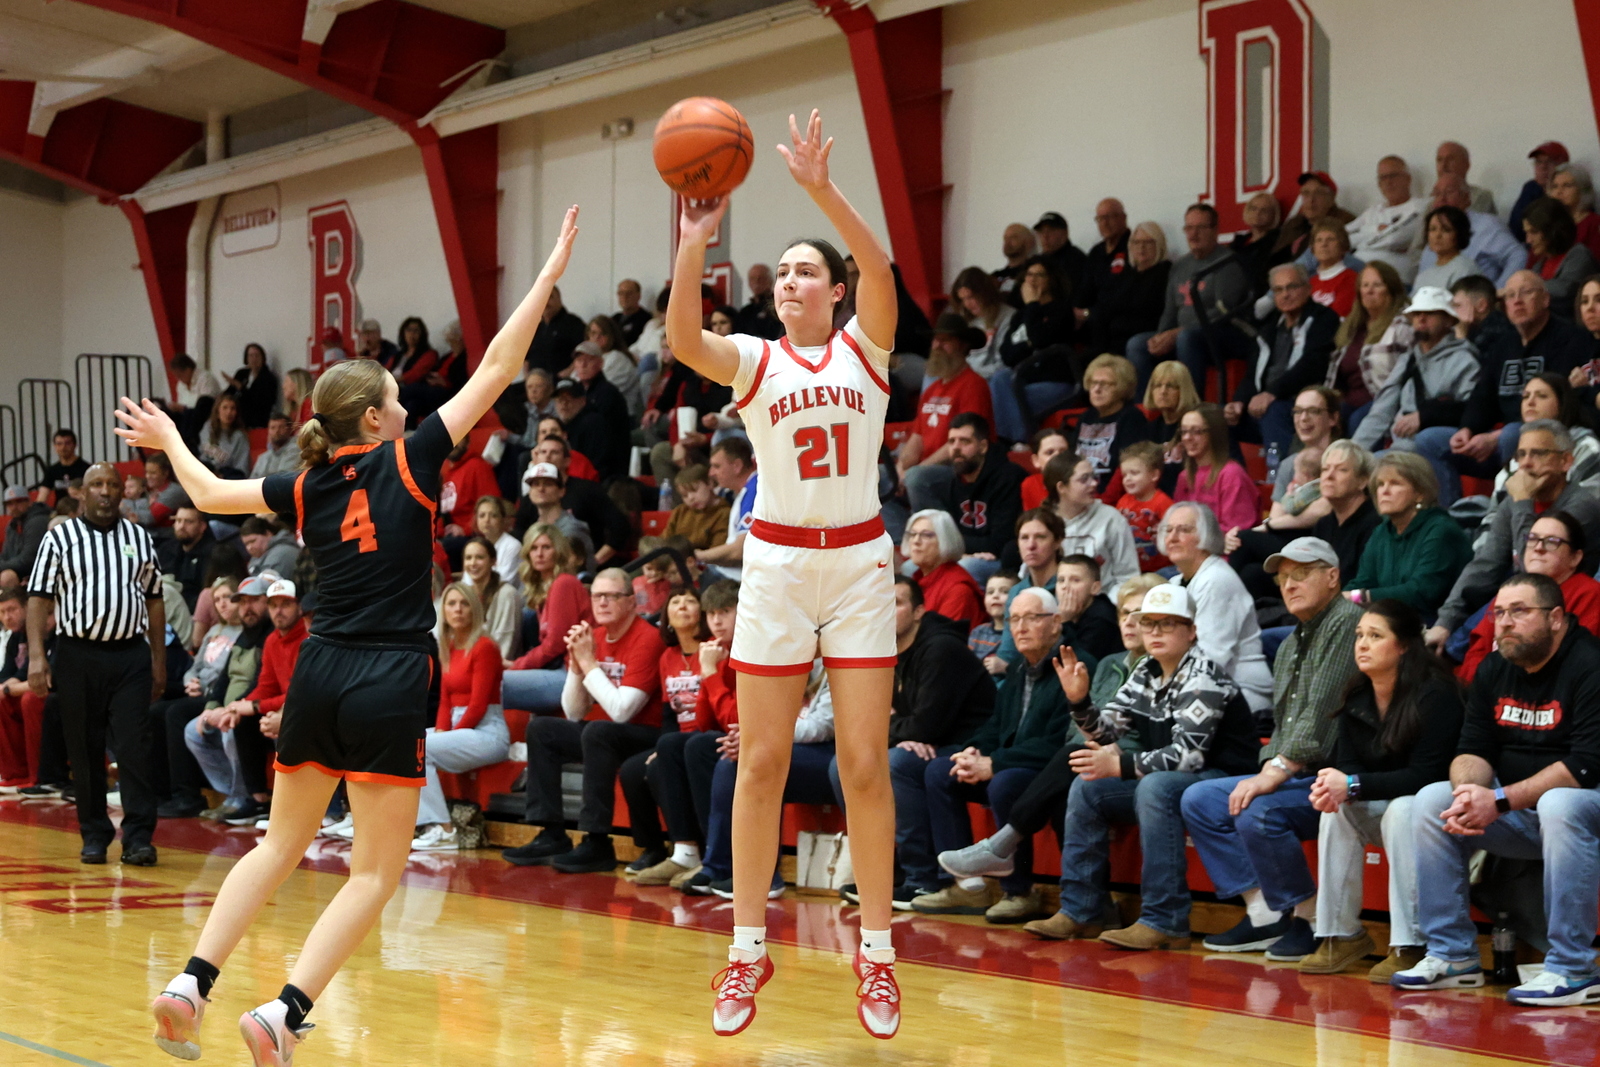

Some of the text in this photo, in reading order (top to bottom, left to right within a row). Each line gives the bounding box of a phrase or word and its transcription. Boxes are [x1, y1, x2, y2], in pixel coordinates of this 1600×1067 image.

[308, 200, 358, 372] R
[768, 386, 866, 427] BELLEVUE
[792, 422, 849, 481] 21
[340, 488, 378, 553] 4
